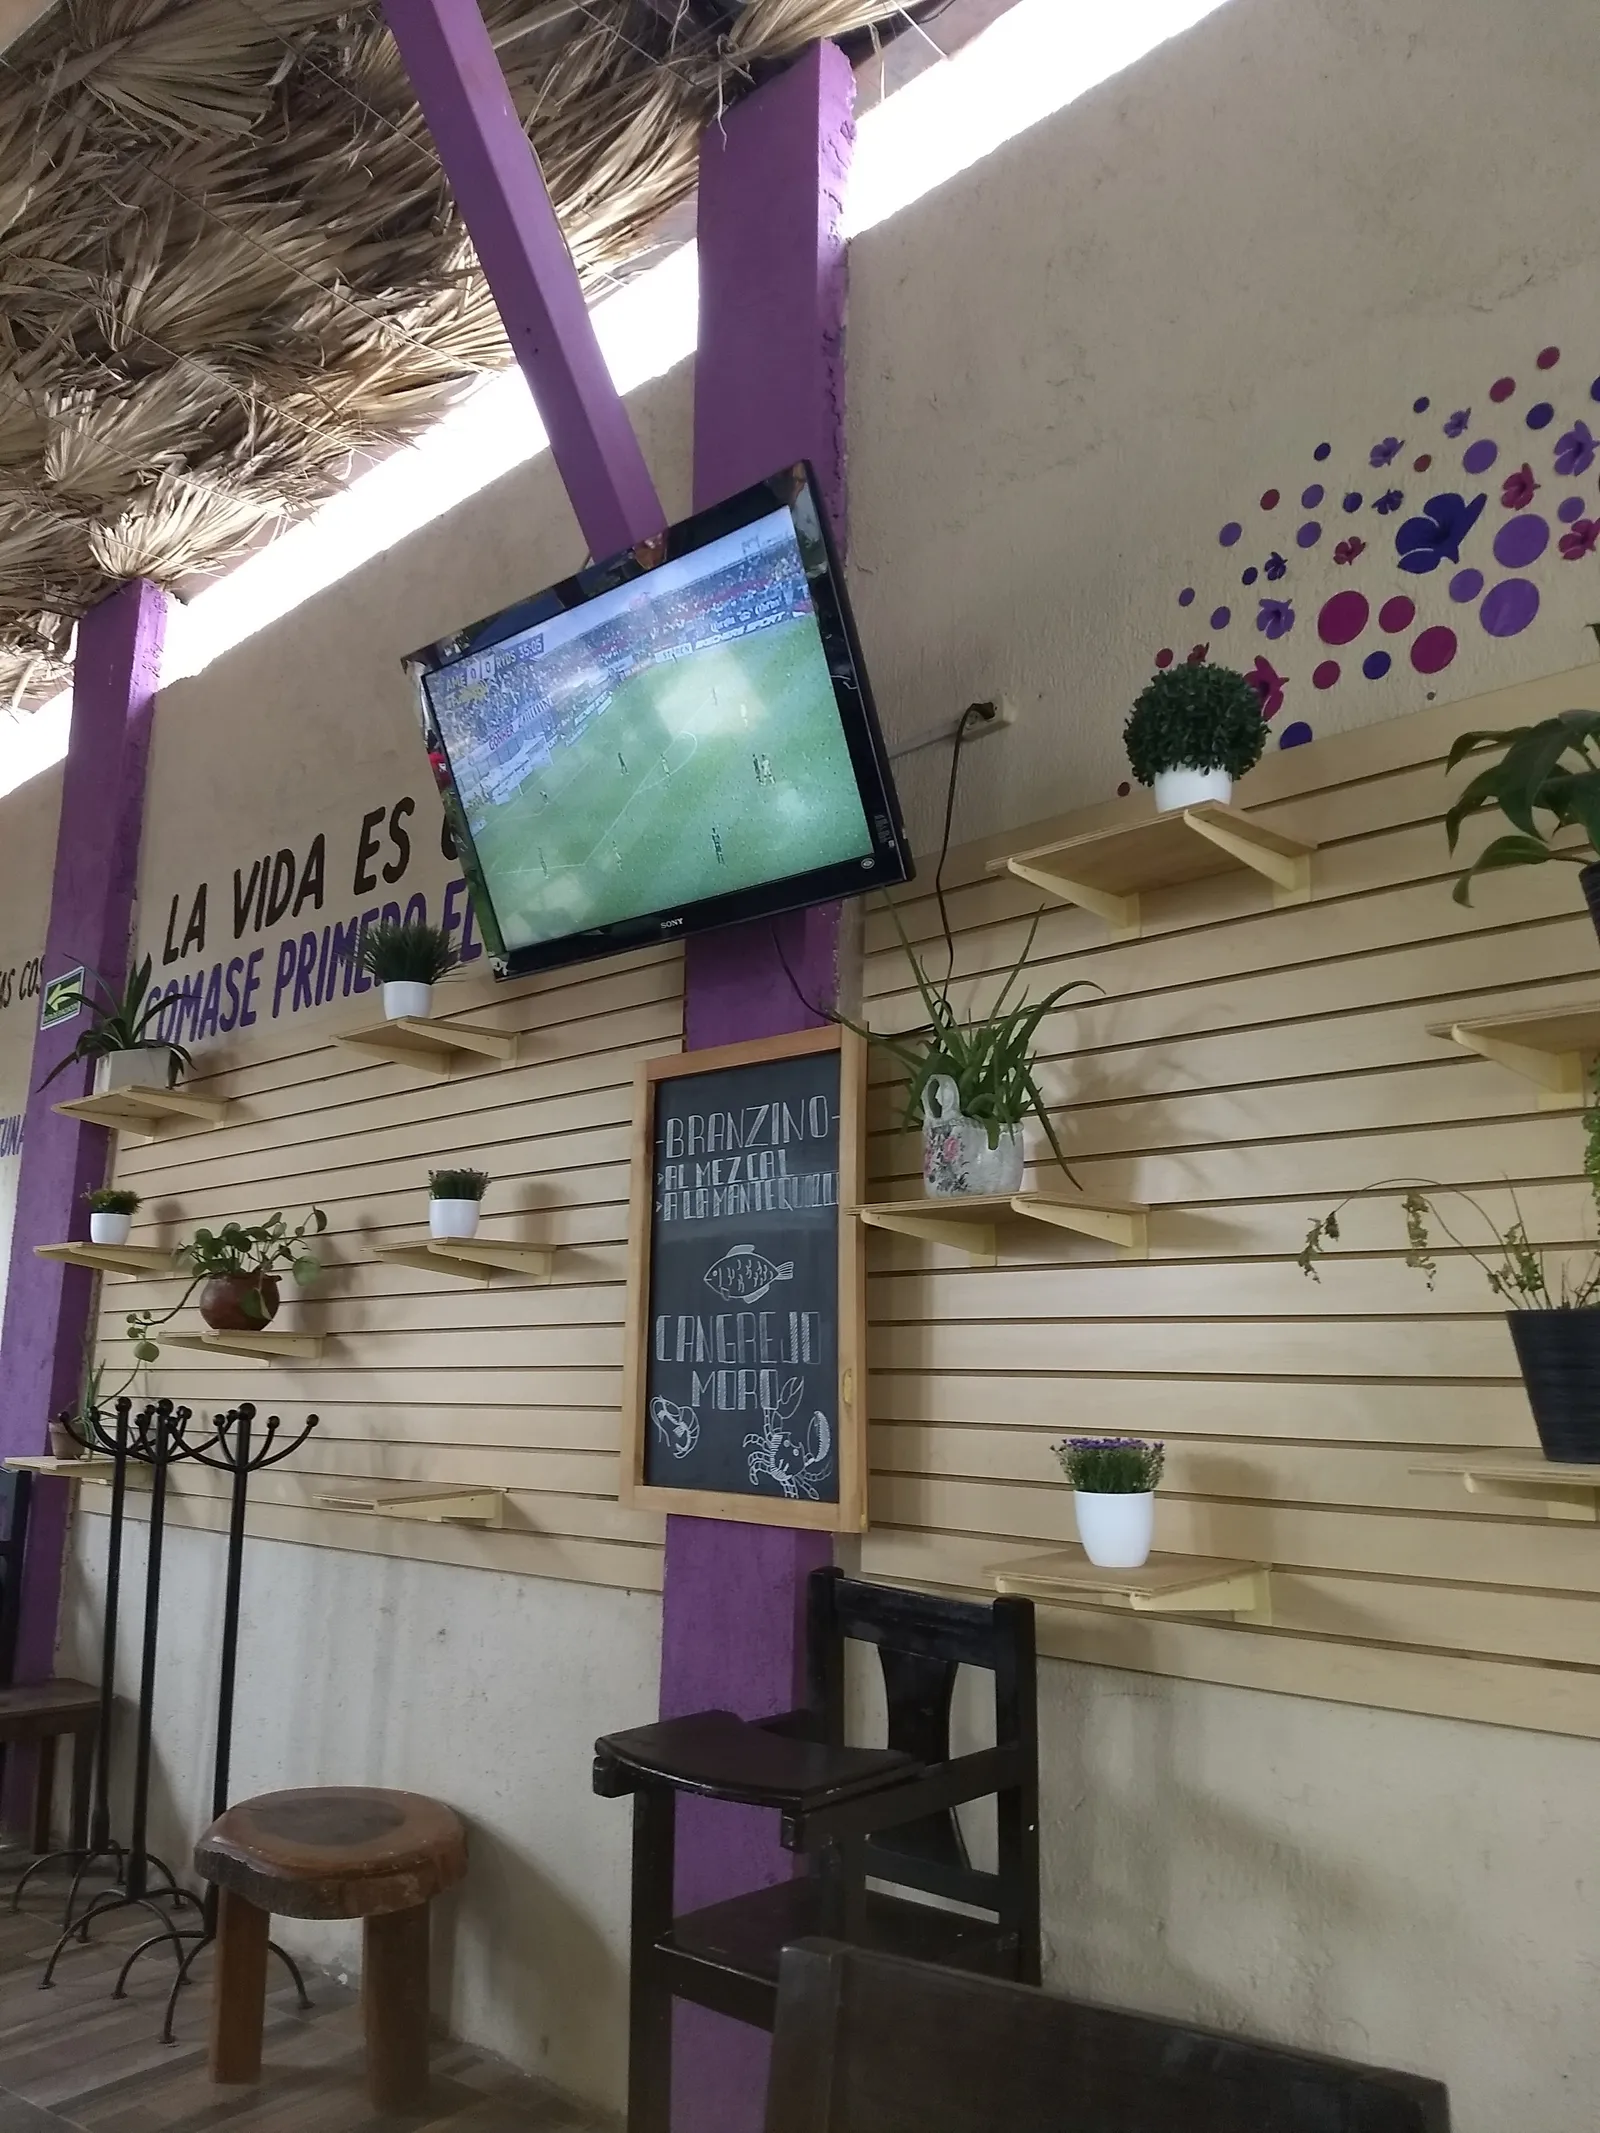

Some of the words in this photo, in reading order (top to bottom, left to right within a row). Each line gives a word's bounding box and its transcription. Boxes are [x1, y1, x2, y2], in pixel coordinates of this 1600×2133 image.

[163, 882, 208, 965] LA
[234, 832, 325, 940] VIDA
[354, 796, 415, 895] ES
[660, 917, 684, 929] SONY
[140, 947, 264, 1045] COMASE
[665, 1163, 688, 1190] AL
[696, 1149, 795, 1188] MEZCAL
[664, 1192, 677, 1221] A
[683, 1188, 708, 1219] LA
[656, 1311, 821, 1364] CANGREJO
[692, 1369, 779, 1410] MORO
